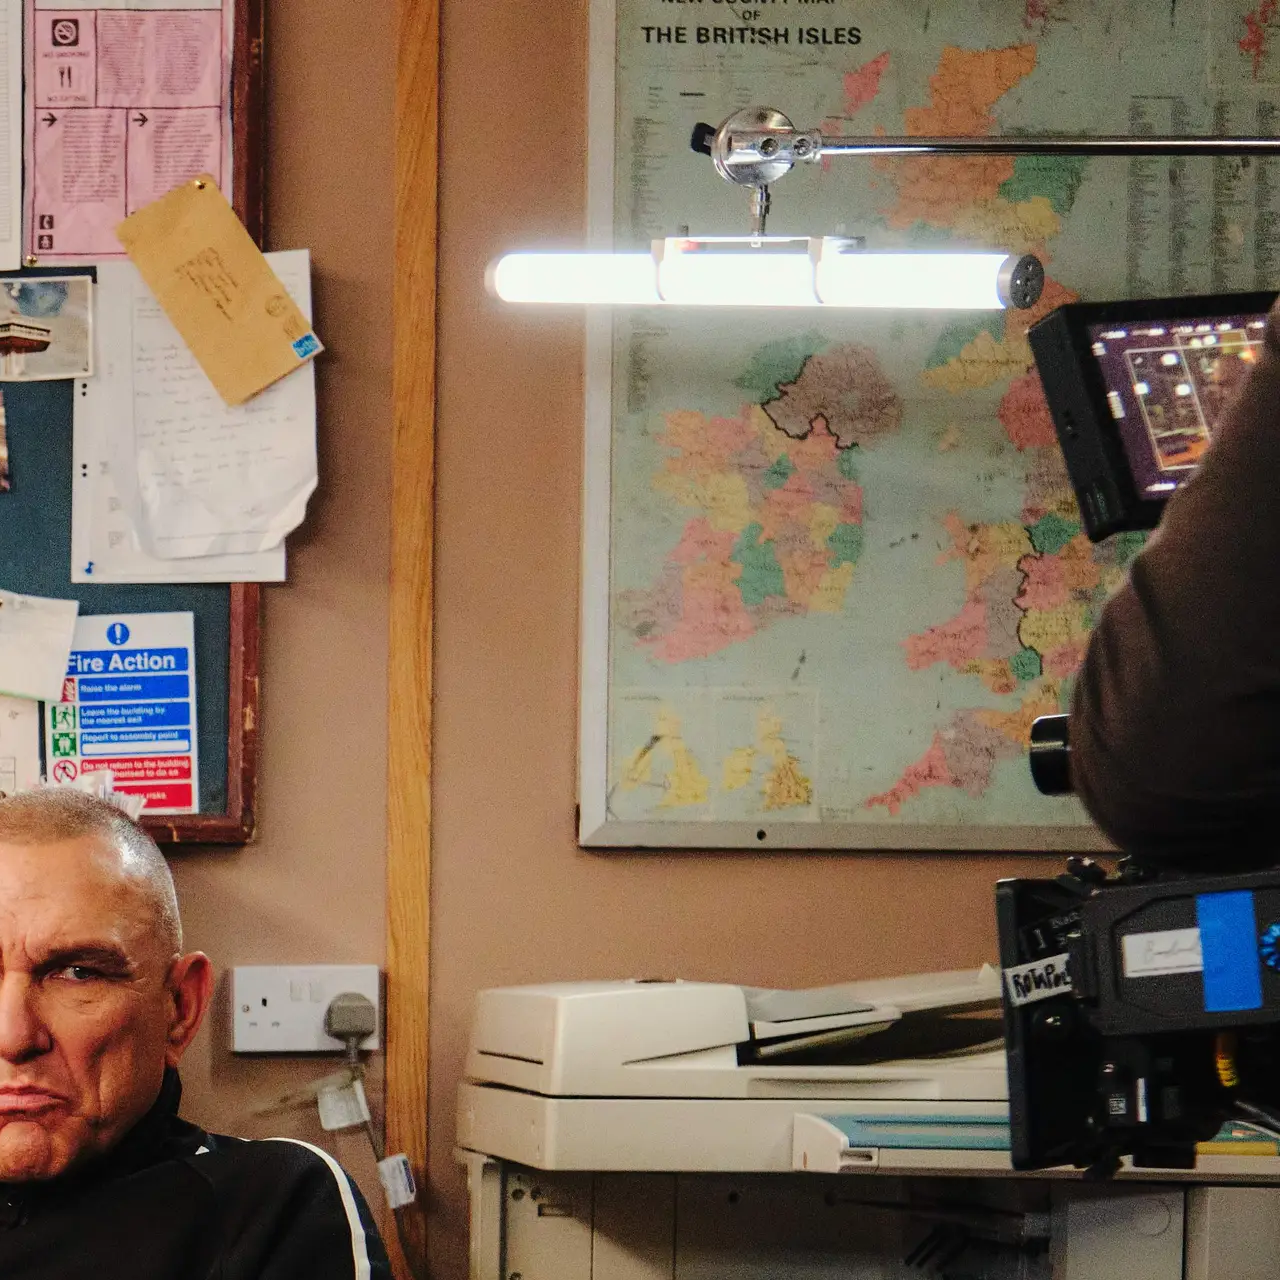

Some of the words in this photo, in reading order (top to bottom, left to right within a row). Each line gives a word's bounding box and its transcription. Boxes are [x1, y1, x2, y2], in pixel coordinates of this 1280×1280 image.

[742, 10, 761, 21] OF
[641, 26, 687, 44] THE
[696, 26, 789, 45] BRITISH
[798, 26, 862, 45] ISLES
[66, 655, 104, 672] Fire
[108, 652, 177, 672] Action
[104, 684, 118, 692] the
[106, 707, 120, 715] the
[121, 706, 154, 716] building
[155, 706, 166, 715] by
[81, 717, 95, 725] the
[82, 733, 109, 742] Report
[110, 733, 118, 741] to
[158, 731, 179, 741] point
[83, 762, 94, 770] Do
[110, 761, 133, 769] return
[143, 760, 156, 768] the
[157, 759, 189, 769] building
